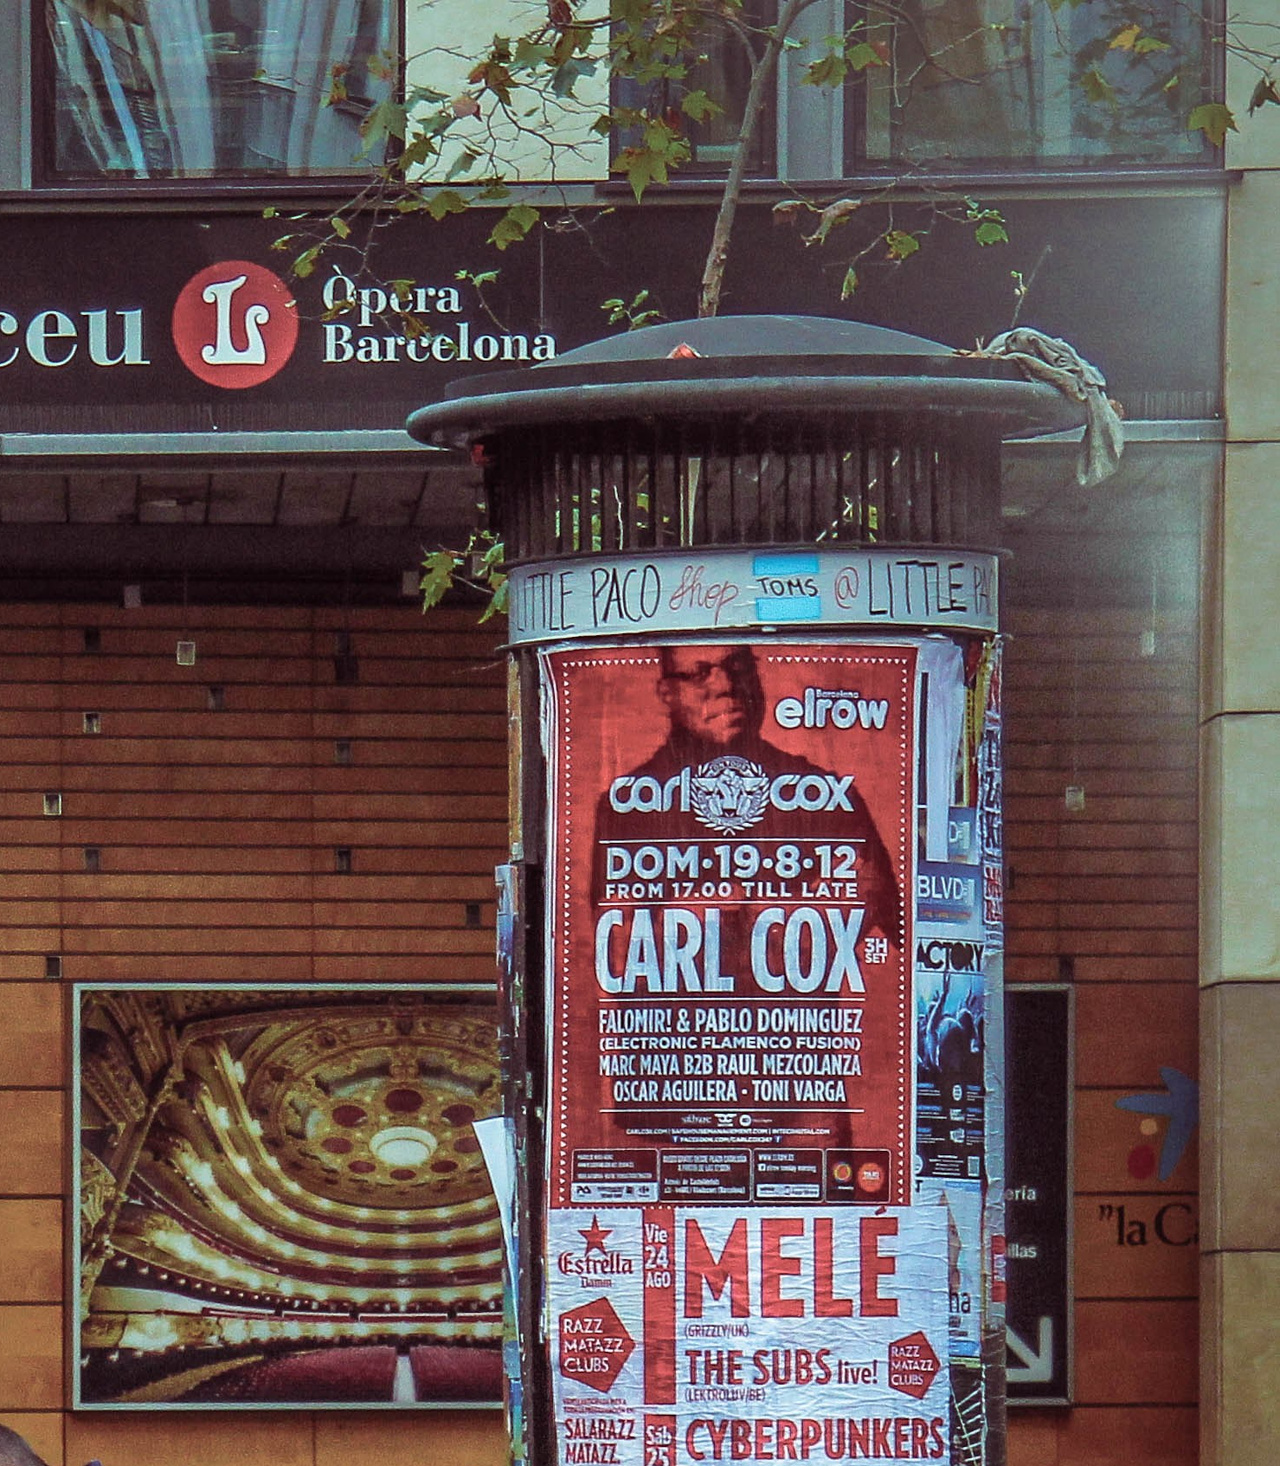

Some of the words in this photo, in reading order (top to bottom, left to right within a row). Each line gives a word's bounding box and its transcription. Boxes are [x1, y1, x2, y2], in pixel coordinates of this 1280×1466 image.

[323, 265, 461, 319] Òpera
[323, 323, 559, 364] Barcelona
[591, 564, 661, 628] PACO
[757, 577, 819, 597] TOMS
[868, 557, 967, 619] LITTLE
[775, 687, 889, 730] elrow
[608, 766, 691, 813] carl
[770, 773, 856, 813] cox
[606, 882, 664, 899] FROM
[672, 881, 732, 899] 17.00
[741, 882, 793, 898] TILL
[802, 882, 858, 898] LATE
[917, 875, 963, 900] BLVD
[594, 907, 735, 993] CARL
[750, 906, 866, 994] COX
[864, 938, 888, 954] 3H
[864, 953, 888, 964] SET
[599, 1009, 672, 1033] FALOMIR!
[676, 1008, 691, 1032] &
[695, 1008, 753, 1033] PABLO
[757, 1008, 863, 1033] DOMINGUEZ
[599, 1036, 698, 1051] (ELECTRONIC
[701, 1036, 792, 1050] FLAMENCO
[795, 1036, 861, 1051] FUSION)
[599, 1054, 637, 1076] MARC
[640, 1054, 680, 1076] MAYA
[683, 1054, 714, 1076] B2B
[717, 1054, 759, 1076] RAUL
[762, 1054, 862, 1076] MEZCOLANZA
[613, 1080, 658, 1102] OSCAR
[662, 1080, 738, 1102] AGUILERA
[752, 1080, 790, 1102] TONI
[793, 1080, 847, 1102] VARGA
[1004, 1185, 1037, 1200] ería
[644, 1223, 669, 1244] Vie
[1154, 1204, 1199, 1247] C
[558, 1251, 634, 1276] Estrella
[644, 1245, 670, 1270] 24
[684, 1206, 899, 1318] MELÉ
[645, 1271, 671, 1289] AGO
[563, 1318, 603, 1334] RAZZ
[684, 1323, 750, 1339] (GRIZZLY/UK)
[564, 1338, 625, 1353] MATAZZ
[891, 1345, 920, 1357] RAZZ
[564, 1357, 610, 1373] CLUBS
[684, 1350, 744, 1386] THE
[753, 1349, 832, 1385] SUBS
[837, 1359, 879, 1384] live!
[891, 1360, 934, 1372] MATAZZ
[891, 1375, 924, 1386] CLUBS
[565, 1418, 636, 1440] SALARAZZ
[686, 1417, 945, 1460] CYBERPUNKERS
